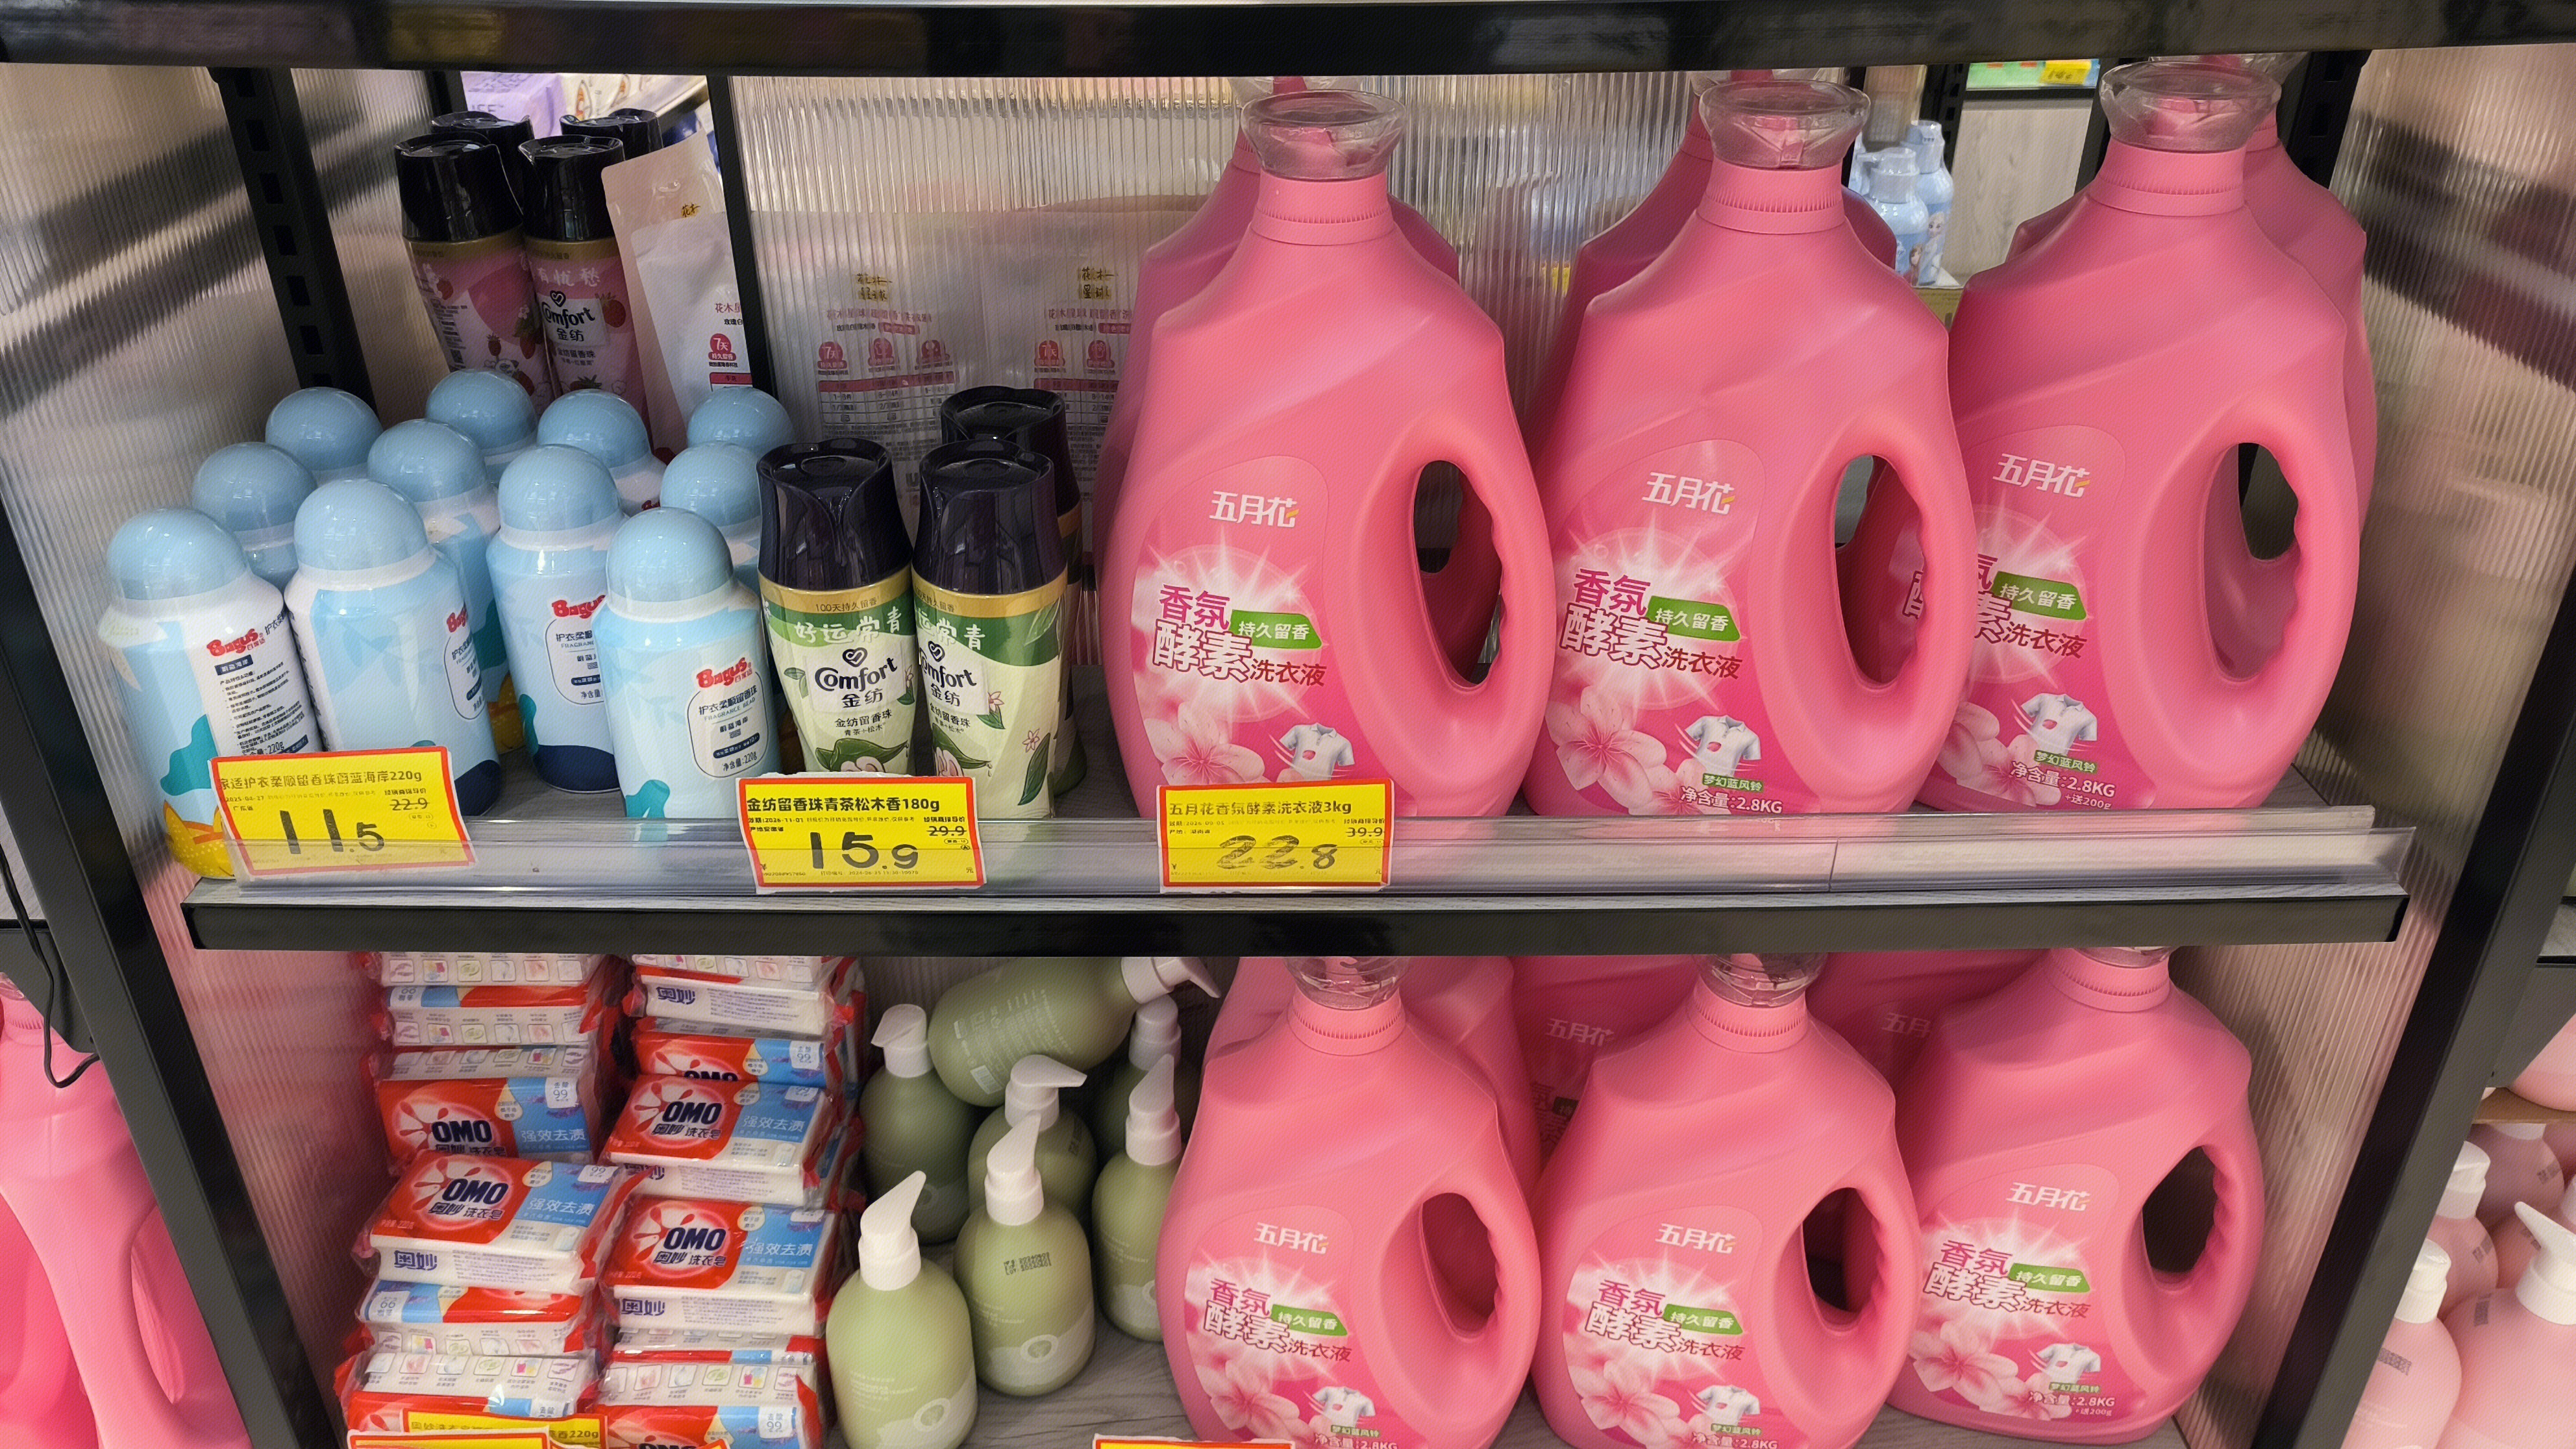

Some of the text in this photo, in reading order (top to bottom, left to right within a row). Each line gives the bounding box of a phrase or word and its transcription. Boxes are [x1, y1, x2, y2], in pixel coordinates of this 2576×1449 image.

[541, 301, 595, 328] Comfort
[556, 328, 584, 342] 金纺
[1992, 452, 2090, 497] 五月花
[1642, 472, 1735, 515] 五月花
[1209, 490, 1299, 528] 五月花
[1574, 568, 1651, 616] 香氛
[2000, 582, 2076, 611] 持久留香
[1159, 583, 1230, 630] 香氛
[794, 606, 902, 644] 好运常青
[1237, 620, 1310, 641] 持久留香
[1655, 608, 1729, 632] 持久留香
[206, 628, 258, 656] Bagus
[1152, 619, 1327, 687] 酵素 洗衣液
[1559, 602, 1742, 679] 酵素 洗衣液
[2003, 621, 2087, 659] 洗衣液
[697, 657, 747, 688] Bagus
[815, 657, 898, 692] Comfort
[919, 647, 977, 688] Comfort
[841, 688, 884, 708] 金纺
[931, 683, 960, 707] 金纺
[835, 708, 893, 728] 金纺留香珠
[391, 798, 428, 811] 22.9
[747, 797, 940, 812] 金纺留香珠青茶松木香180g
[1169, 800, 1352, 815] 五月花香氛酵素洗衣液3kg
[928, 826, 965, 836] 29.9
[1346, 827, 1383, 837] 39.9
[656, 986, 696, 1005] 奥妙
[662, 1101, 723, 1124] OMO
[743, 1115, 806, 1133] 强效去渍
[432, 1120, 492, 1143] OMO
[521, 1128, 586, 1143] 强效去渍
[652, 1123, 721, 1139] 奥妙 洗衣皂
[442, 1178, 509, 1204] OMO
[2006, 1182, 2090, 1211] 五月花
[428, 1202, 504, 1219] 奥妙 洗衣皂
[527, 1198, 595, 1216] 强效去渍
[663, 1227, 726, 1250] OMO
[748, 1242, 813, 1256] 强效去渍
[1254, 1222, 1329, 1254] 五月花
[1655, 1223, 1736, 1254] 五月花
[394, 1250, 438, 1270] 奥妙
[654, 1251, 726, 1267] 奥妙 洗衣皂
[1940, 1240, 2012, 1276] 香氛
[1210, 1278, 1271, 1316] 香氛
[1599, 1279, 1666, 1316] 香氛
[1923, 1262, 2091, 1319] 酵素 洗衣液
[621, 1298, 665, 1315] 奥妙
[1204, 1300, 1352, 1363] 酵素 洗衣液
[1584, 1300, 1746, 1361] 酵素 洗衣液
